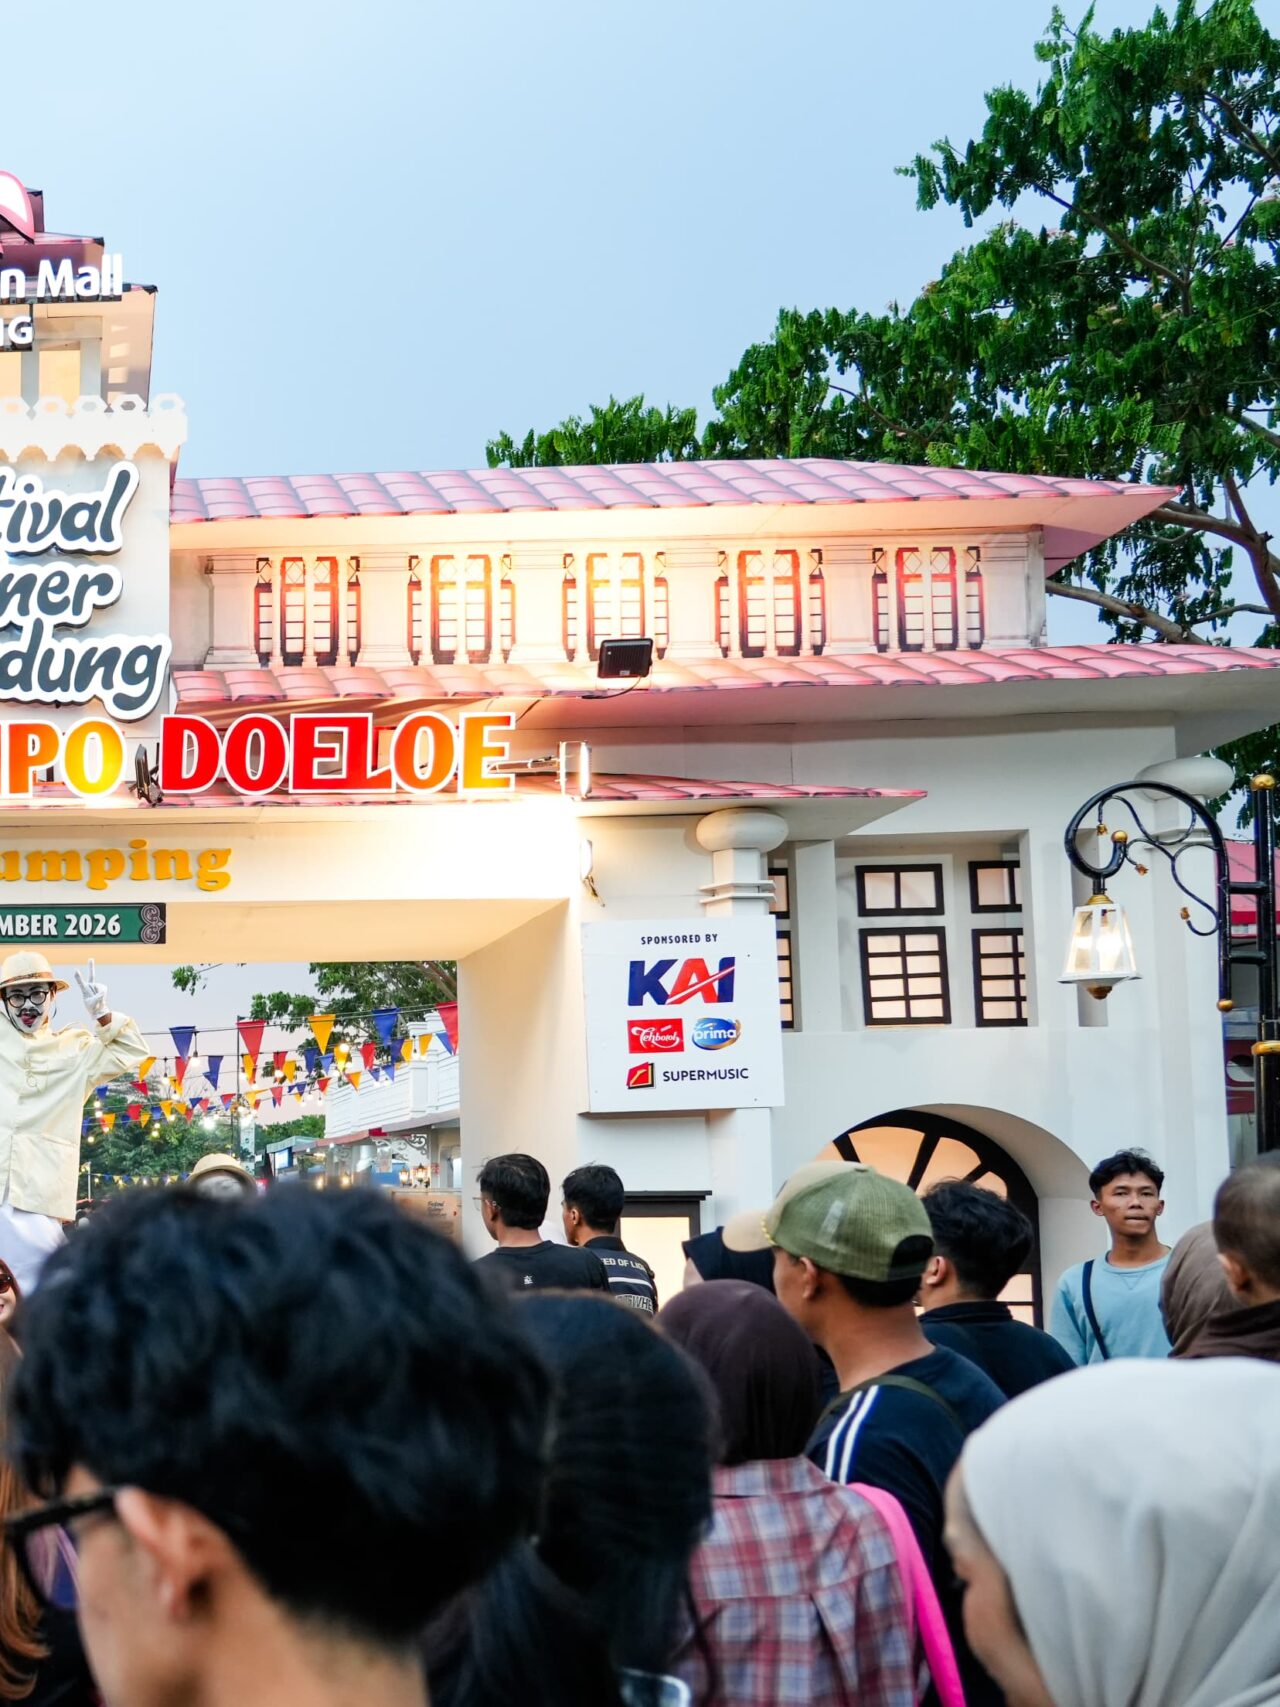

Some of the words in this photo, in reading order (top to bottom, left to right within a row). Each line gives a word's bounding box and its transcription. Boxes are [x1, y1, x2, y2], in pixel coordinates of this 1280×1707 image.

[37, 254, 123, 300] Mall
[158, 712, 516, 795] DOELOE
[66, 913, 121, 936] 2026
[641, 934, 701, 945] SPONSORED
[705, 933, 718, 943] BY
[628, 957, 735, 1006] KAI
[694, 1027, 737, 1040] prima
[662, 1068, 749, 1081] SUPERMUSIC
